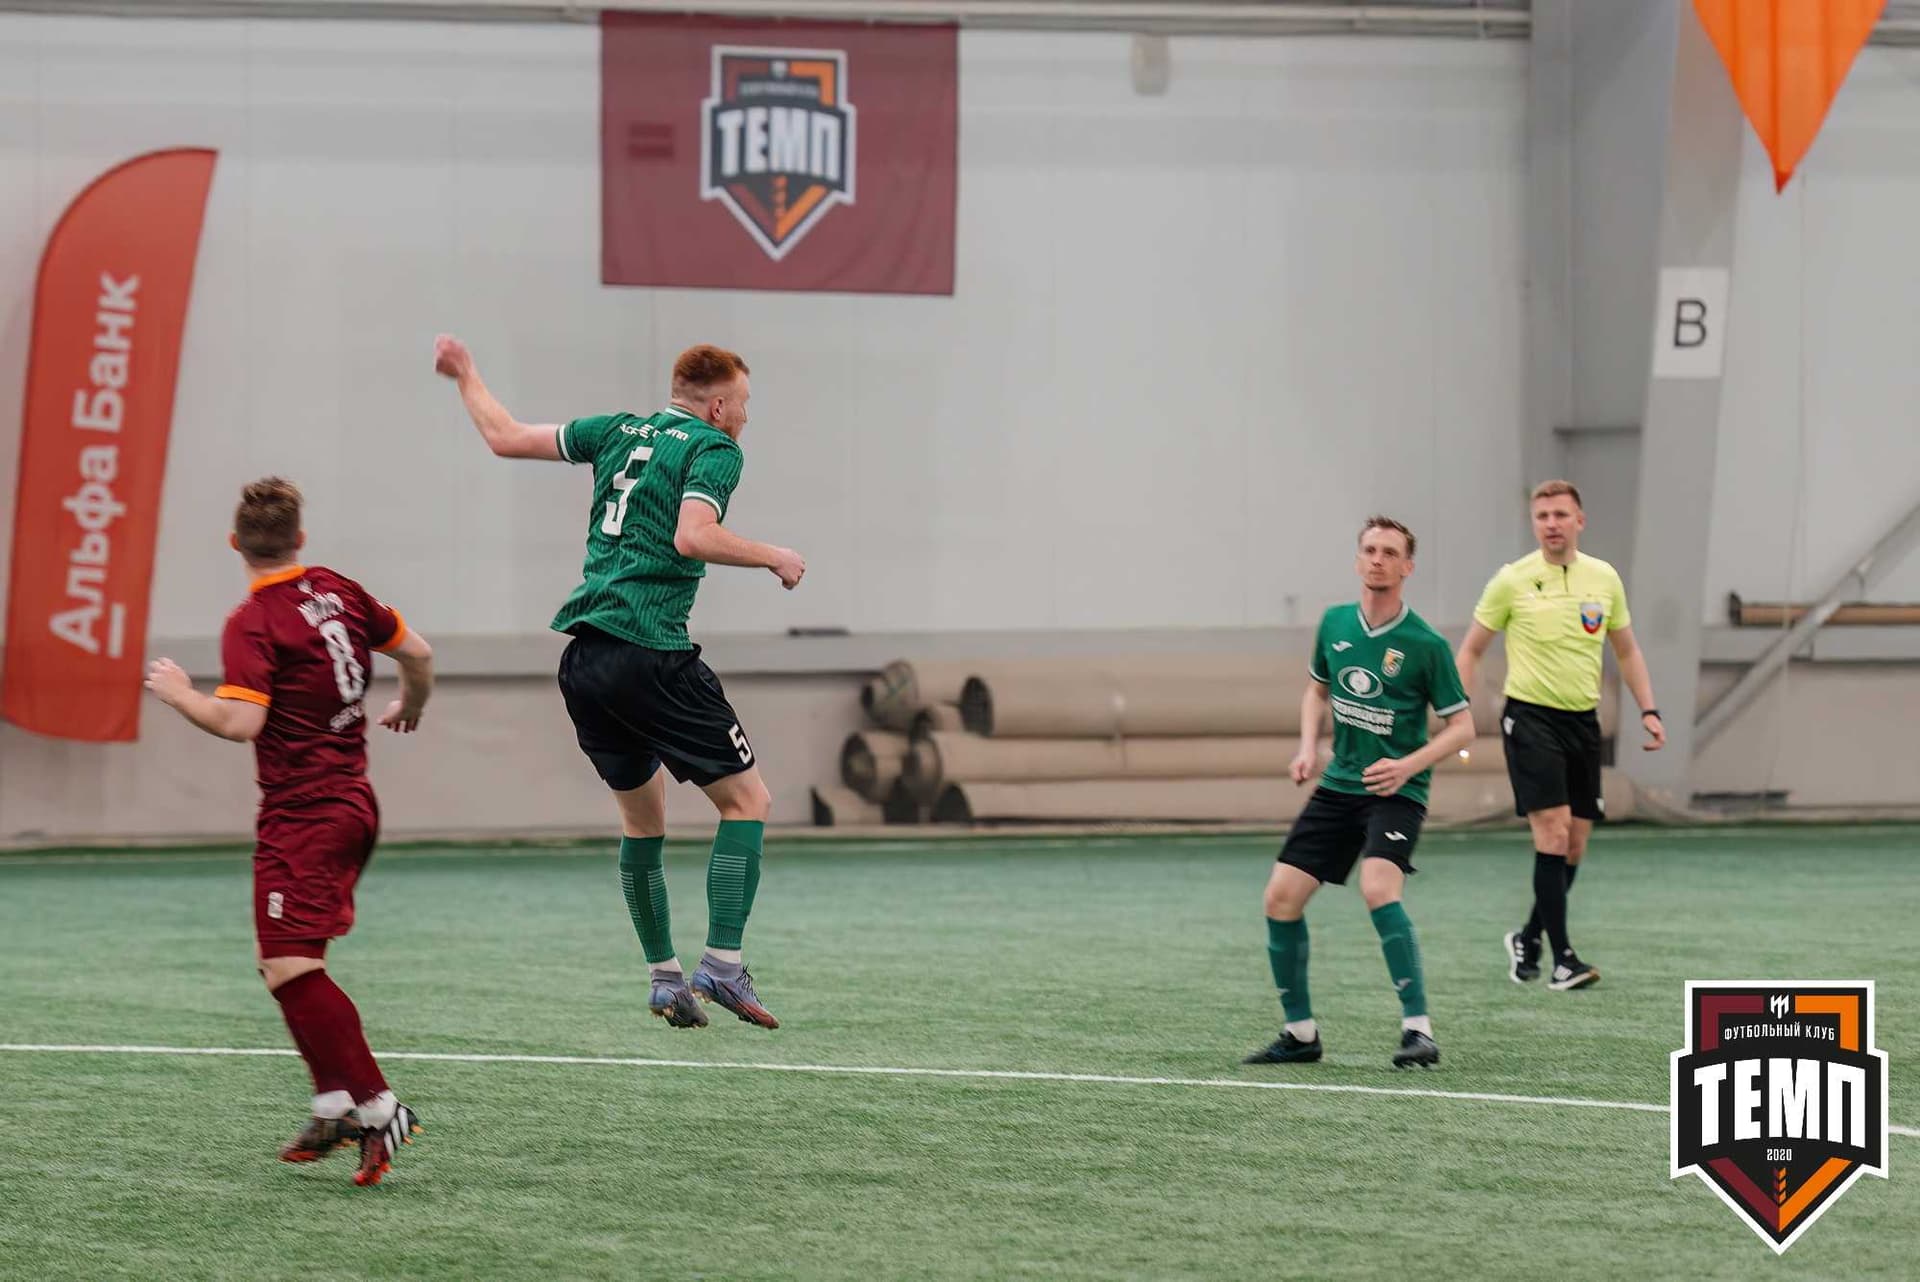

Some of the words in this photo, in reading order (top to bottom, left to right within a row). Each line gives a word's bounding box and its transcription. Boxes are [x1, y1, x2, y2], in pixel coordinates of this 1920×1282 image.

[716, 106, 841, 181] ТЕМП
[72, 271, 140, 432] Банк
[601, 446, 654, 536] 5
[48, 445, 126, 656] Альфа
[728, 723, 752, 765] 5
